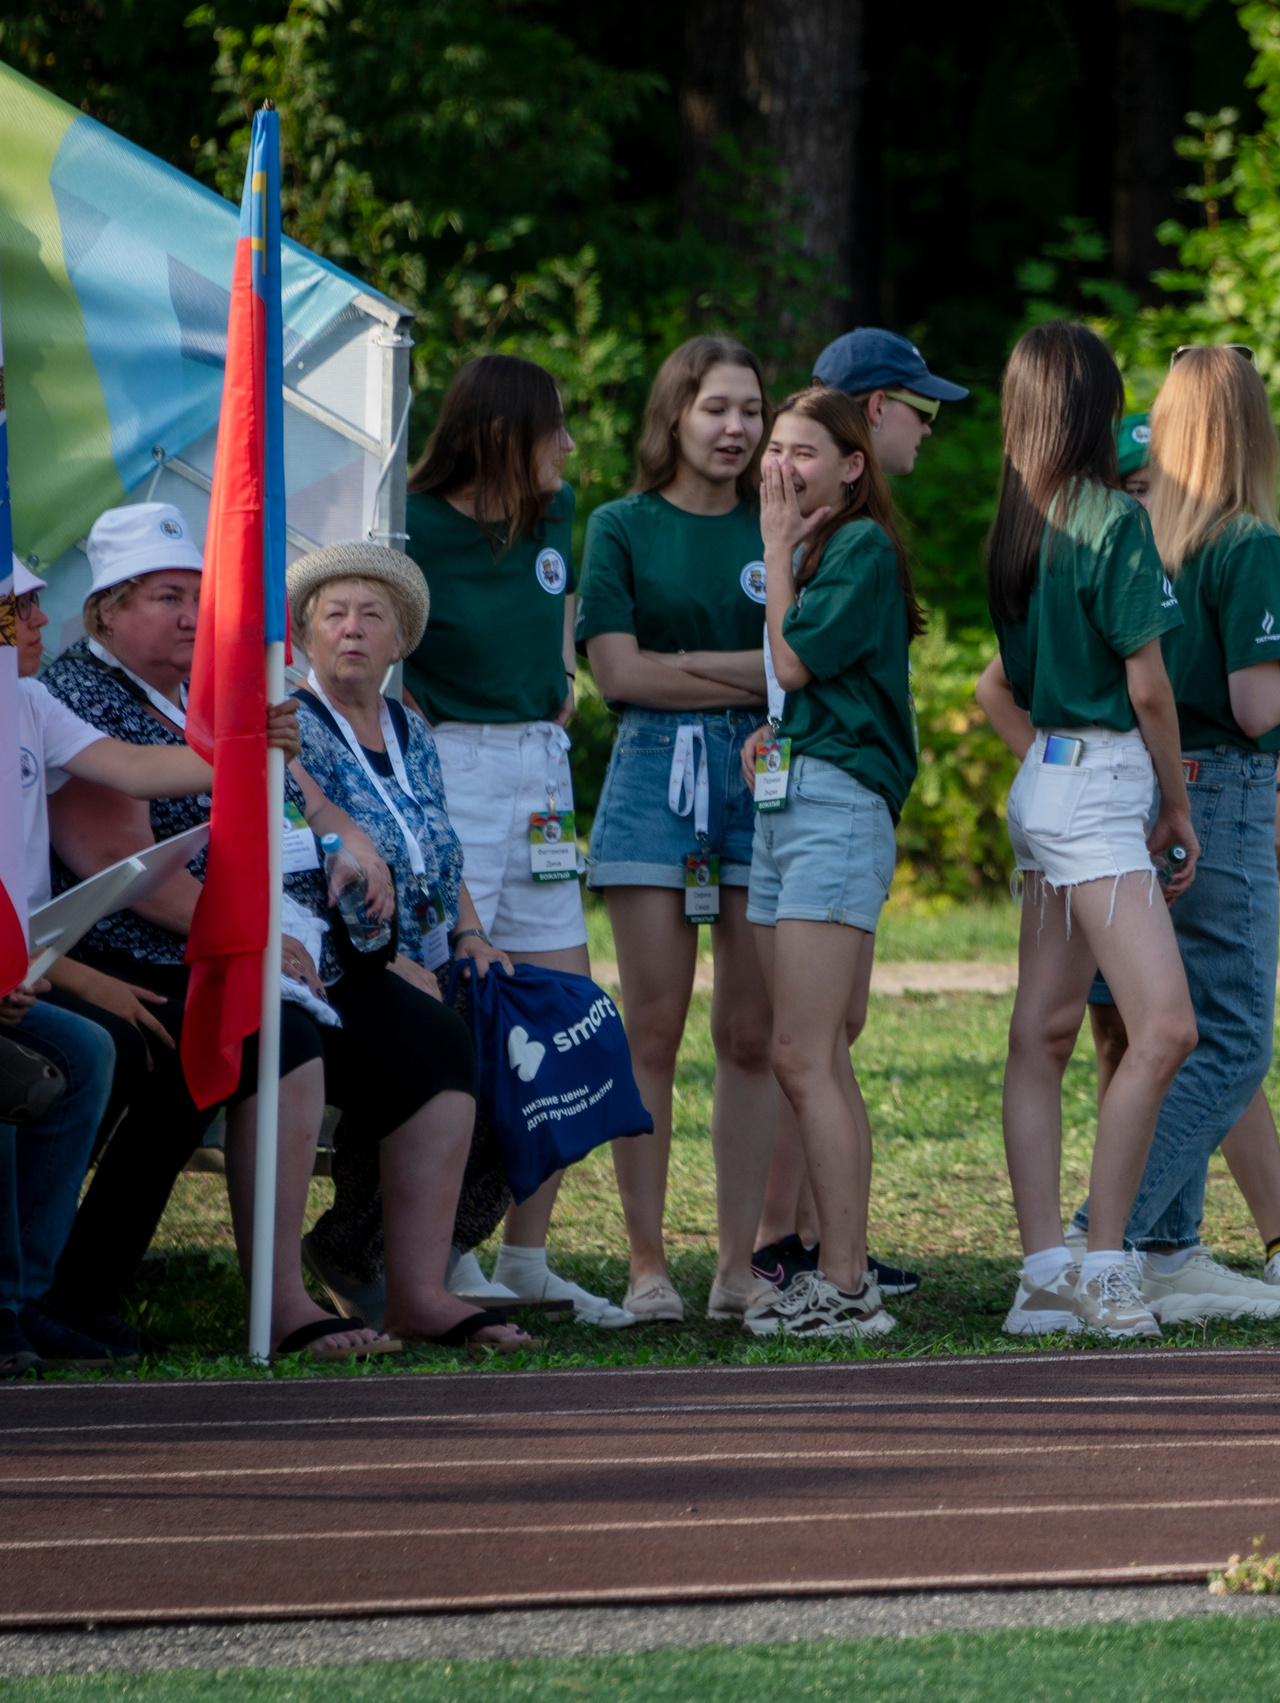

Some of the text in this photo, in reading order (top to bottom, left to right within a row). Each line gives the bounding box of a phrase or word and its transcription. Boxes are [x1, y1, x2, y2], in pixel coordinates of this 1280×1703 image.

[539, 871, 571, 881] ВОЖАТЫЙ
[552, 994, 617, 1053] smart
[521, 1084, 590, 1116] низкие цены
[526, 1077, 614, 1132] для лучшей жизни
